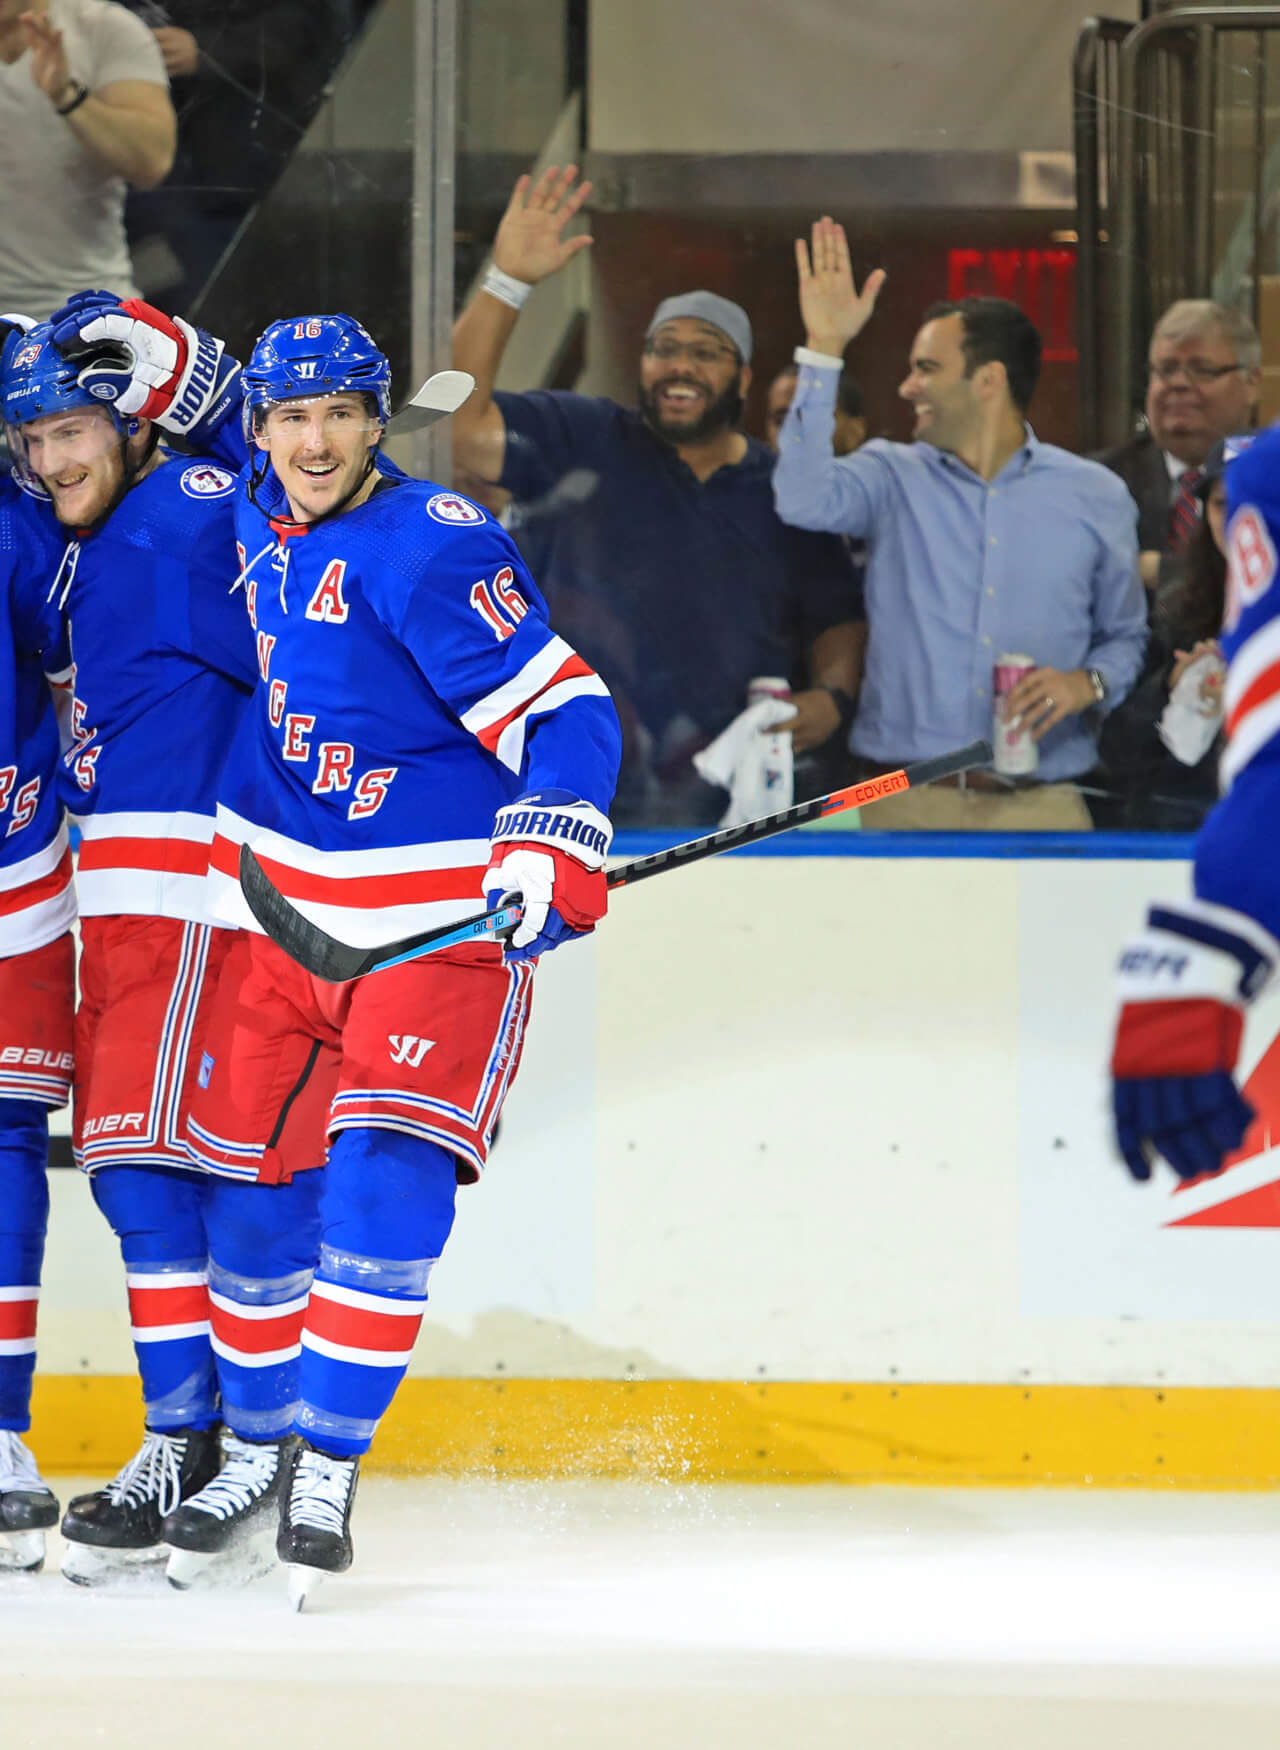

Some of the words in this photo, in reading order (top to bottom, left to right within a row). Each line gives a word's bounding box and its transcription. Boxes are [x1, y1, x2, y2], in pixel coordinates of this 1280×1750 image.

[293, 322, 322, 340] 16
[305, 558, 350, 625] A
[470, 566, 529, 642] 16
[855, 773, 909, 802] COVERT
